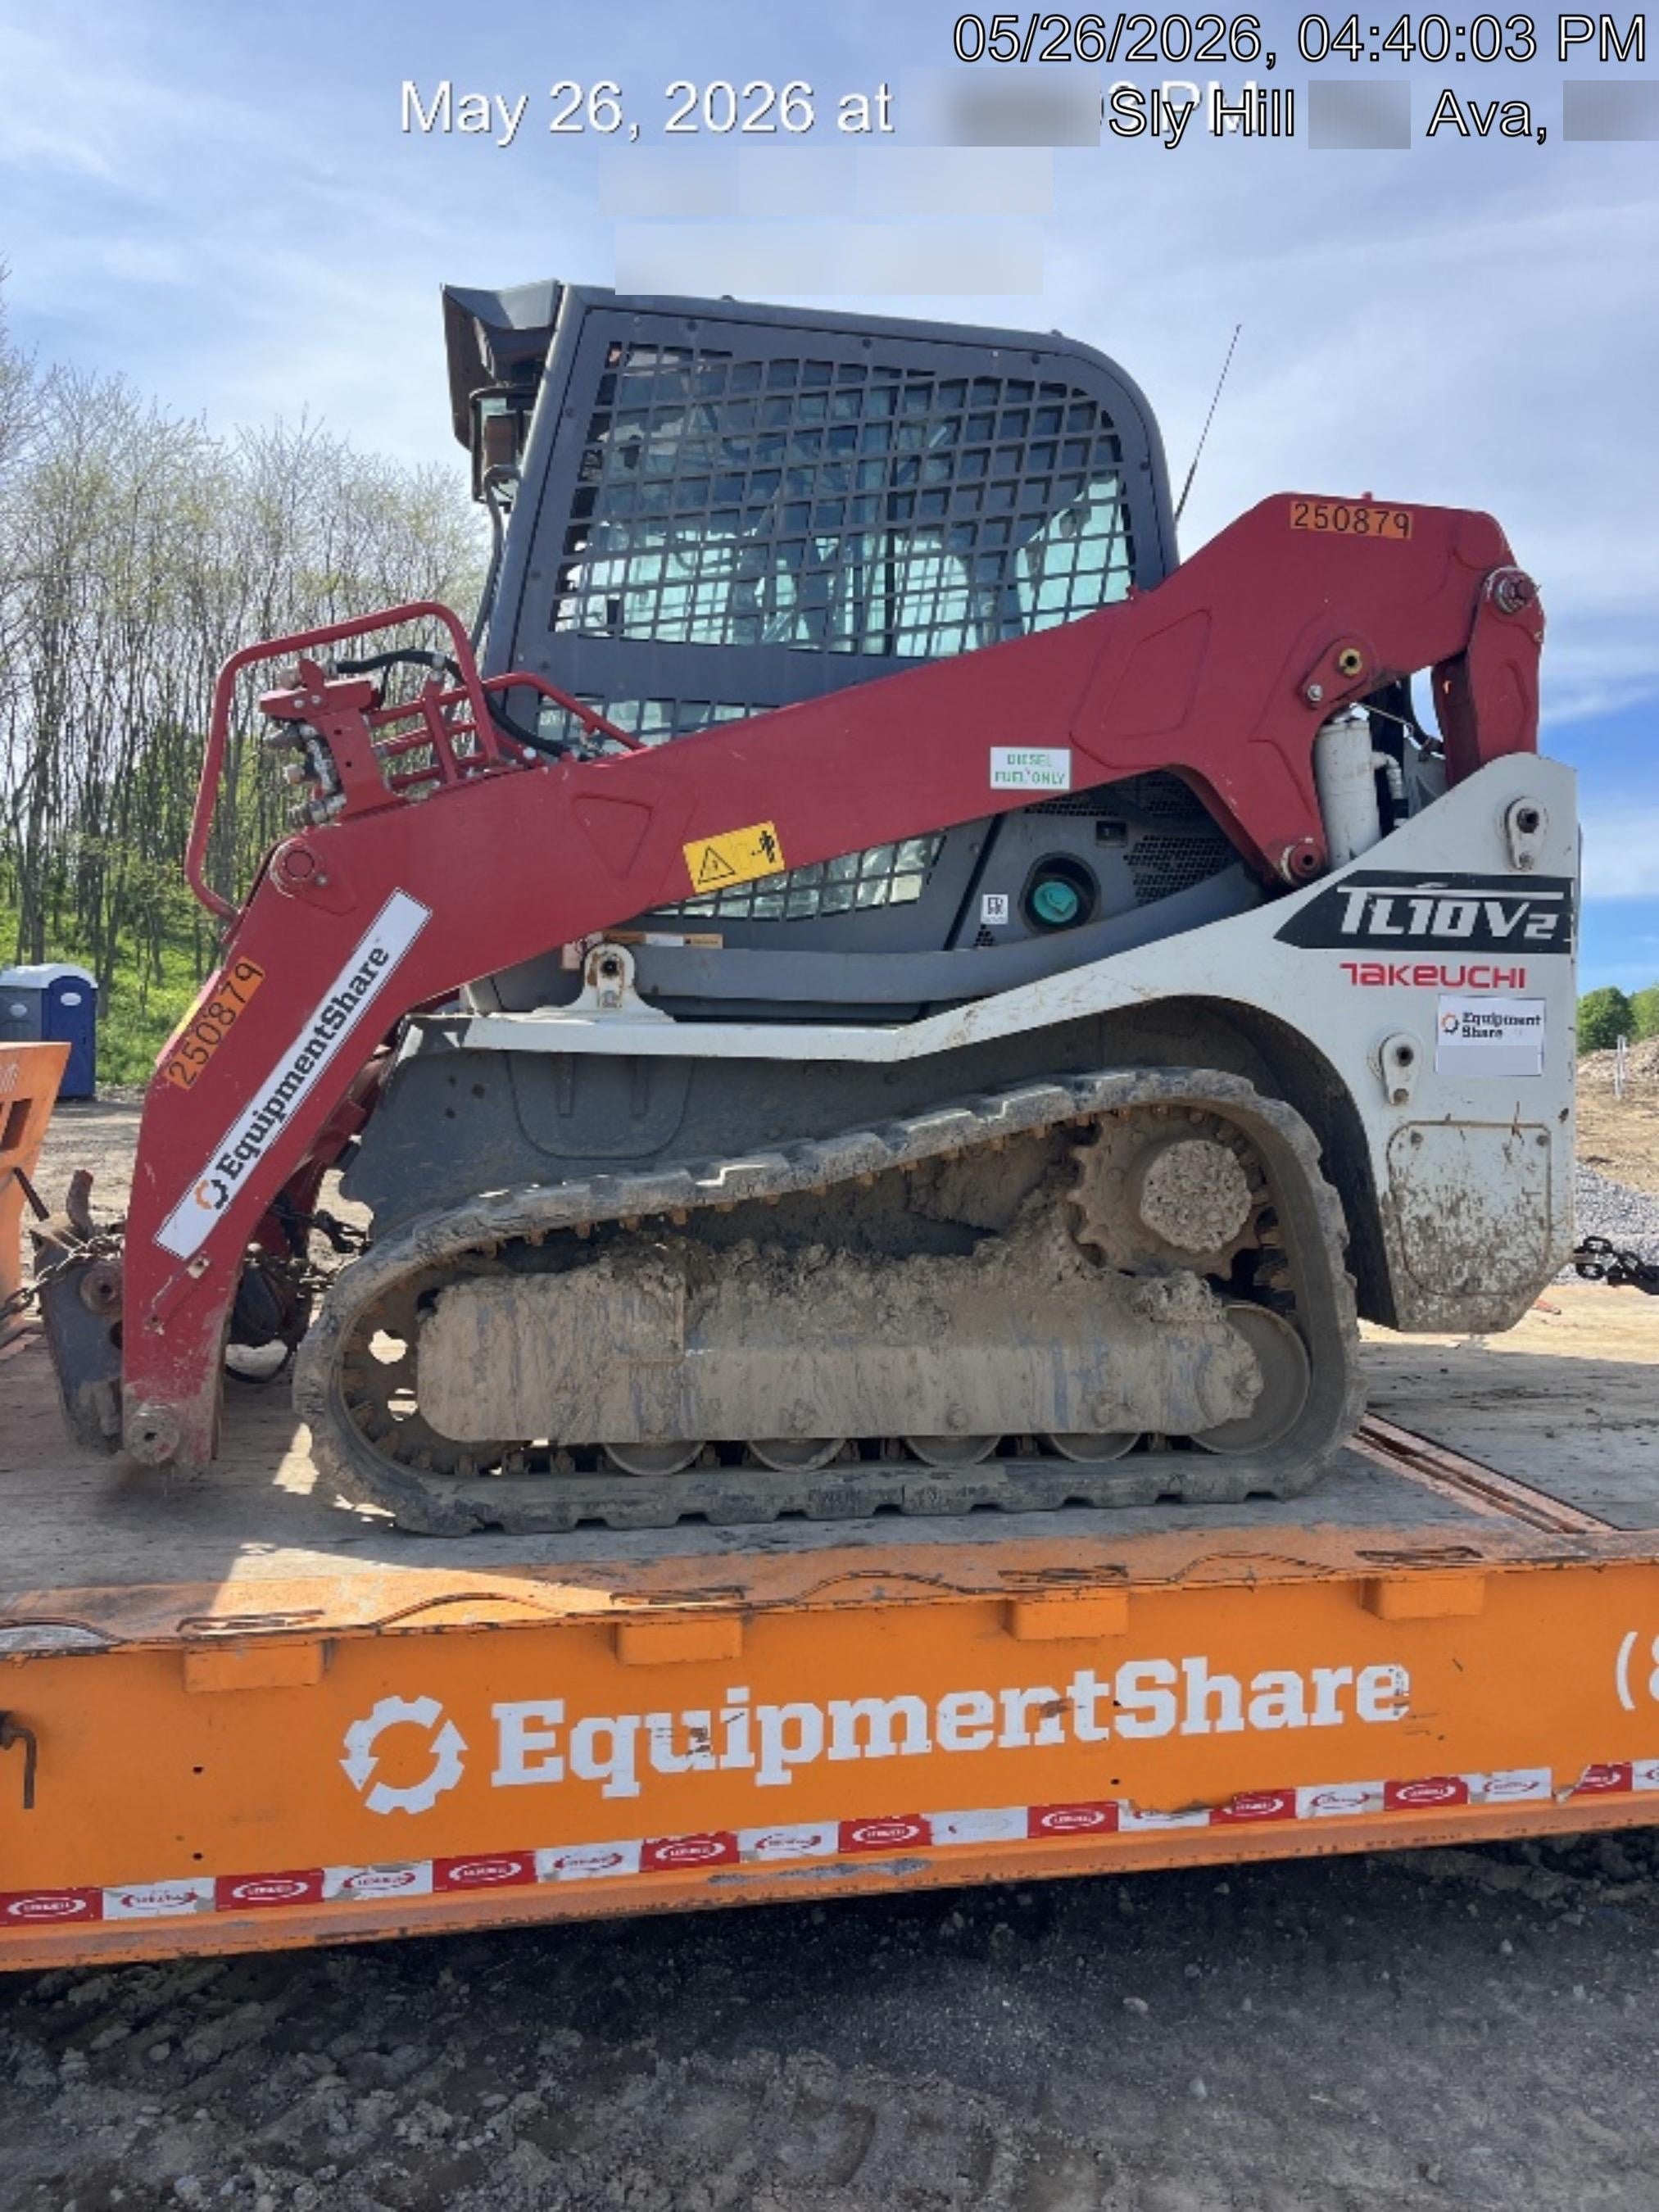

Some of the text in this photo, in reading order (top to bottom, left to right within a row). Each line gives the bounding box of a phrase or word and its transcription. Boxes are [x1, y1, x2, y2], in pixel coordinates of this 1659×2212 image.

[1294, 502, 1410, 537] 250879
[1006, 753, 1053, 767] DIESEL
[995, 771, 1066, 785] FUEL ONLY
[168, 961, 265, 1082] 250879
[1462, 1011, 1542, 1027] Equipment
[1462, 1024, 1503, 1038] Share
[215, 946, 390, 1181] EquipmentShare
[491, 1656, 1410, 1799] EquipmentShare
